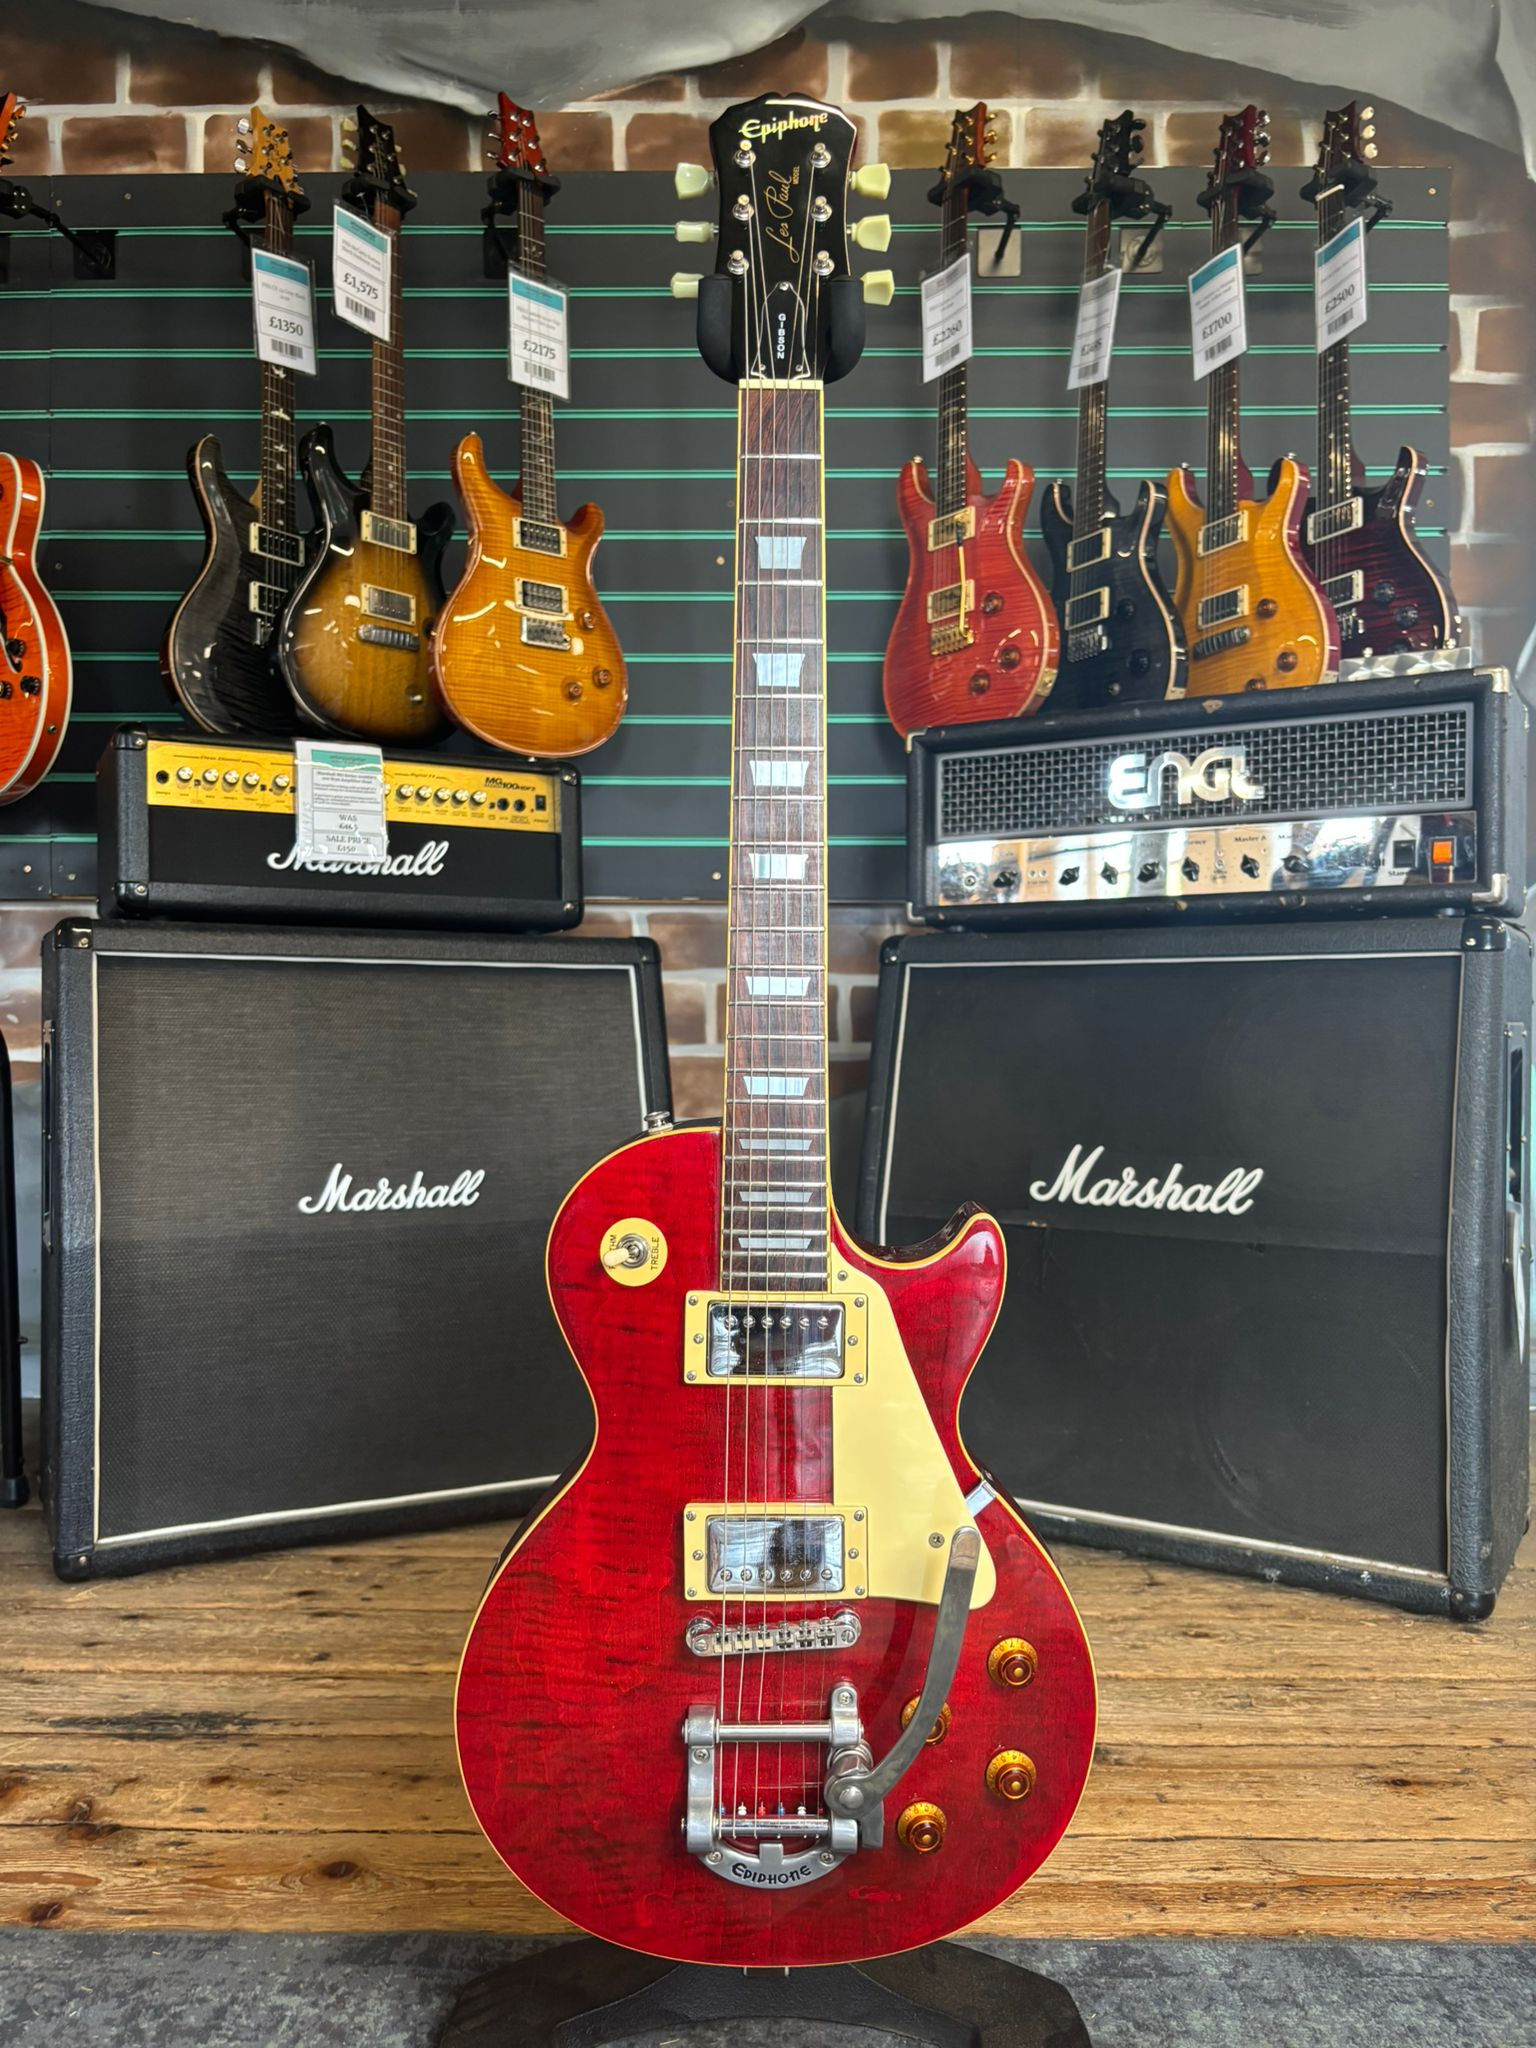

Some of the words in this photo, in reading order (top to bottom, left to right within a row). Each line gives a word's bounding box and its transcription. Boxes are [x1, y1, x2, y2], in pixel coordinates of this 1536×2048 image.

[738, 110, 828, 144] Epiphone
[763, 169, 794, 219] Paul
[765, 223, 800, 264] Les
[343, 272, 379, 300] £1,575
[269, 316, 304, 336] £1350
[777, 313, 787, 360] GIBSON
[523, 339, 556, 360] £2175
[339, 814, 358, 822] WAS
[326, 834, 347, 844] SALE
[298, 1162, 485, 1214] Marshall
[1029, 1143, 1264, 1215] Marshall
[650, 1236, 660, 1271] TREBLE
